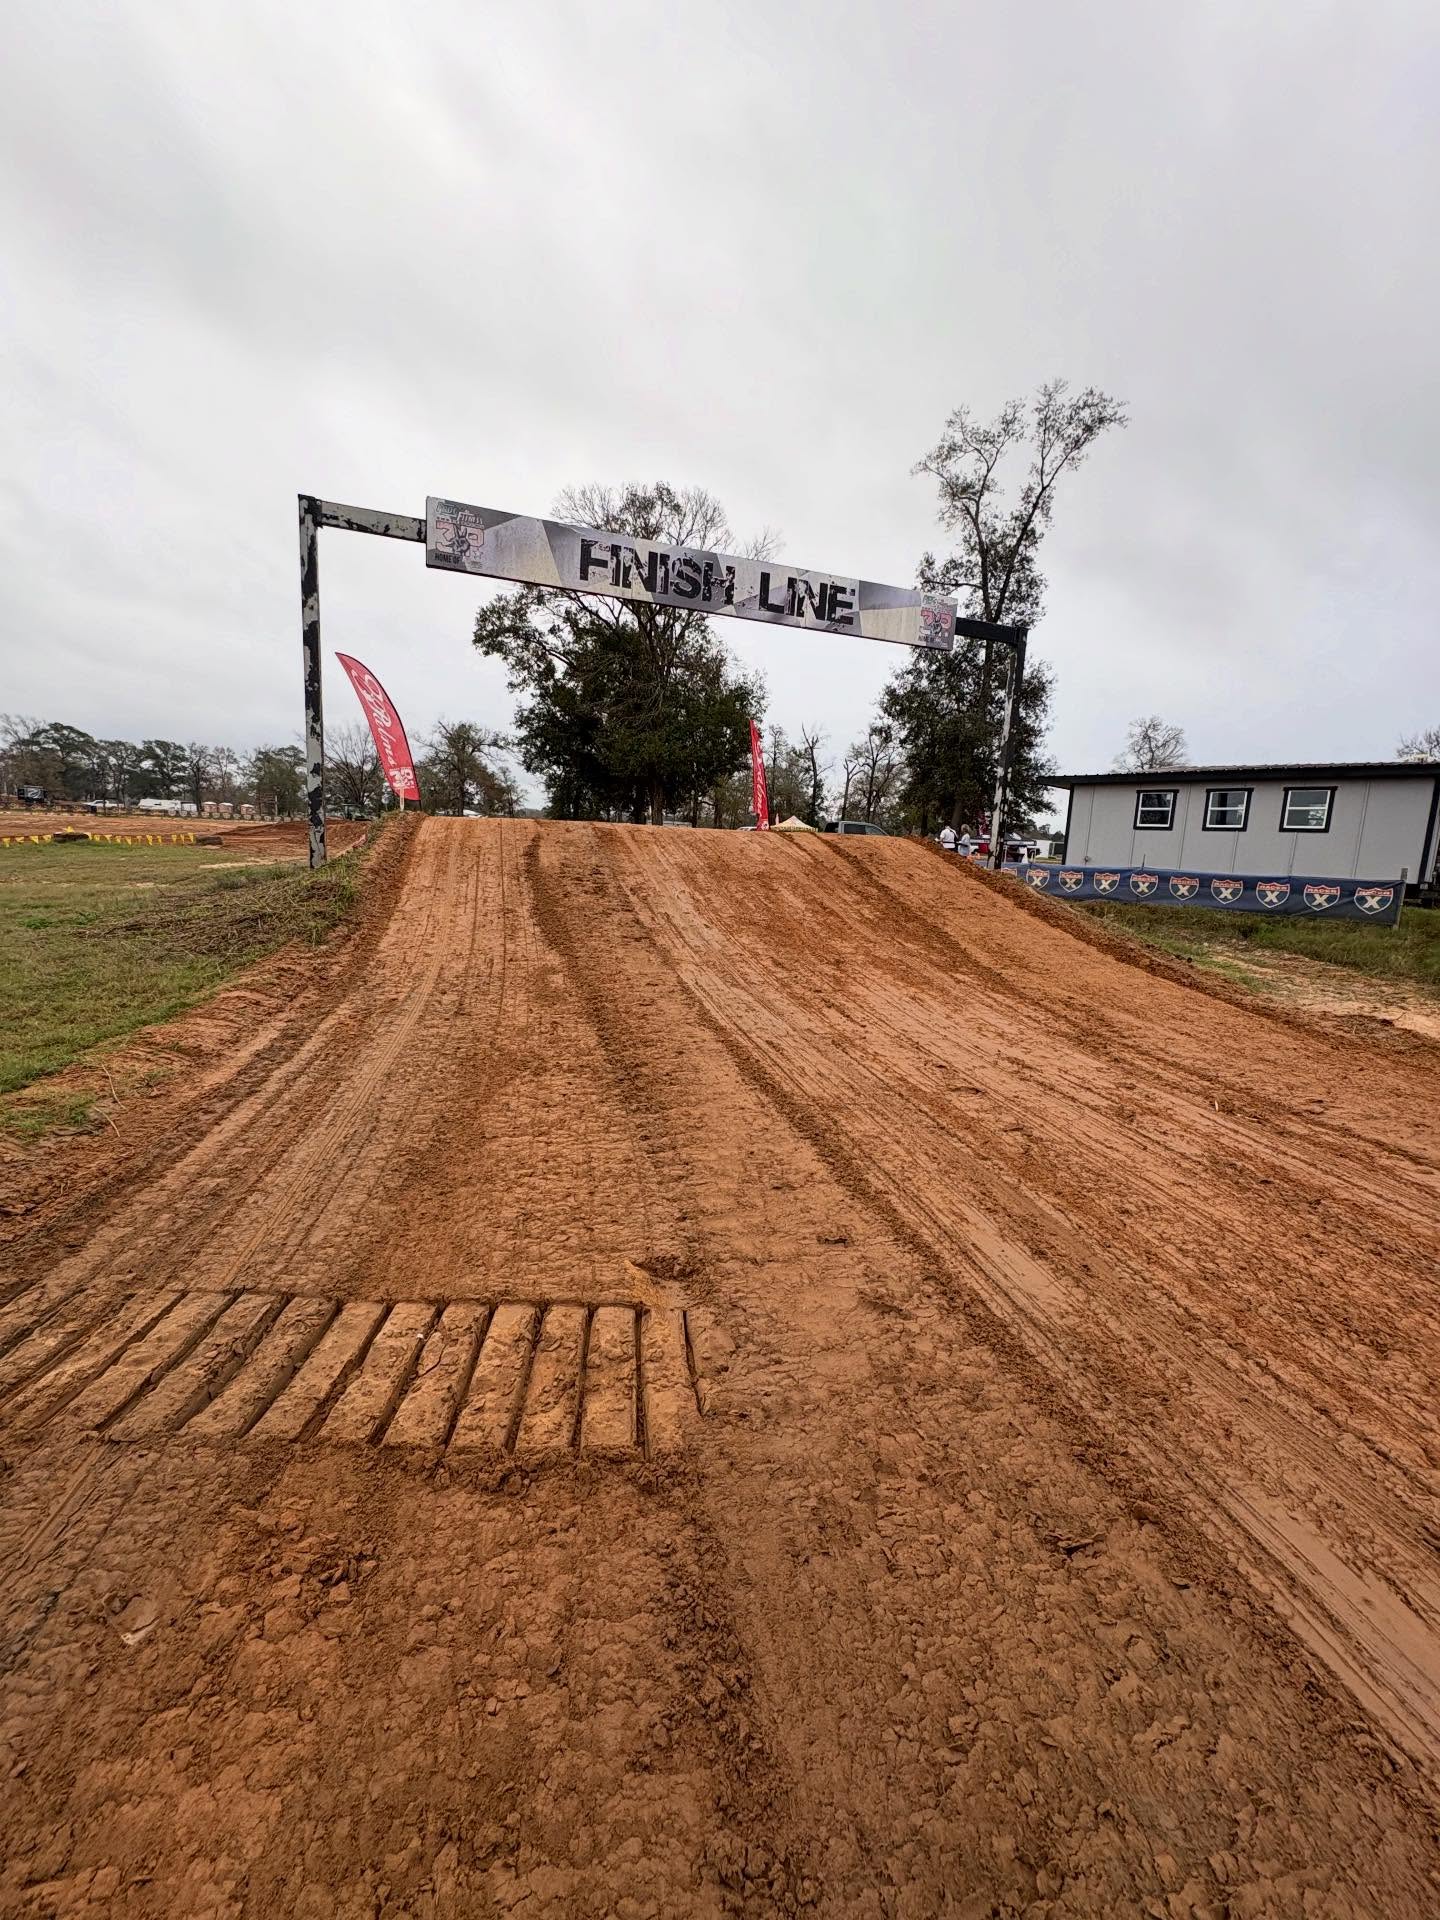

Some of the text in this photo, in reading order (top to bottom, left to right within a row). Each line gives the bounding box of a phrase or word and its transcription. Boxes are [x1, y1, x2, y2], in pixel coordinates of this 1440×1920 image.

[579, 538, 856, 626] FINISH LINE
[1031, 876, 1043, 886] X
[1065, 878, 1077, 888] X
[1099, 879, 1112, 890] X
[1136, 880, 1150, 893] X
[1176, 884, 1191, 896] X
[1218, 887, 1234, 900] X
[1263, 890, 1280, 903] X
[1311, 893, 1330, 906] X
[1362, 895, 1382, 909] X
